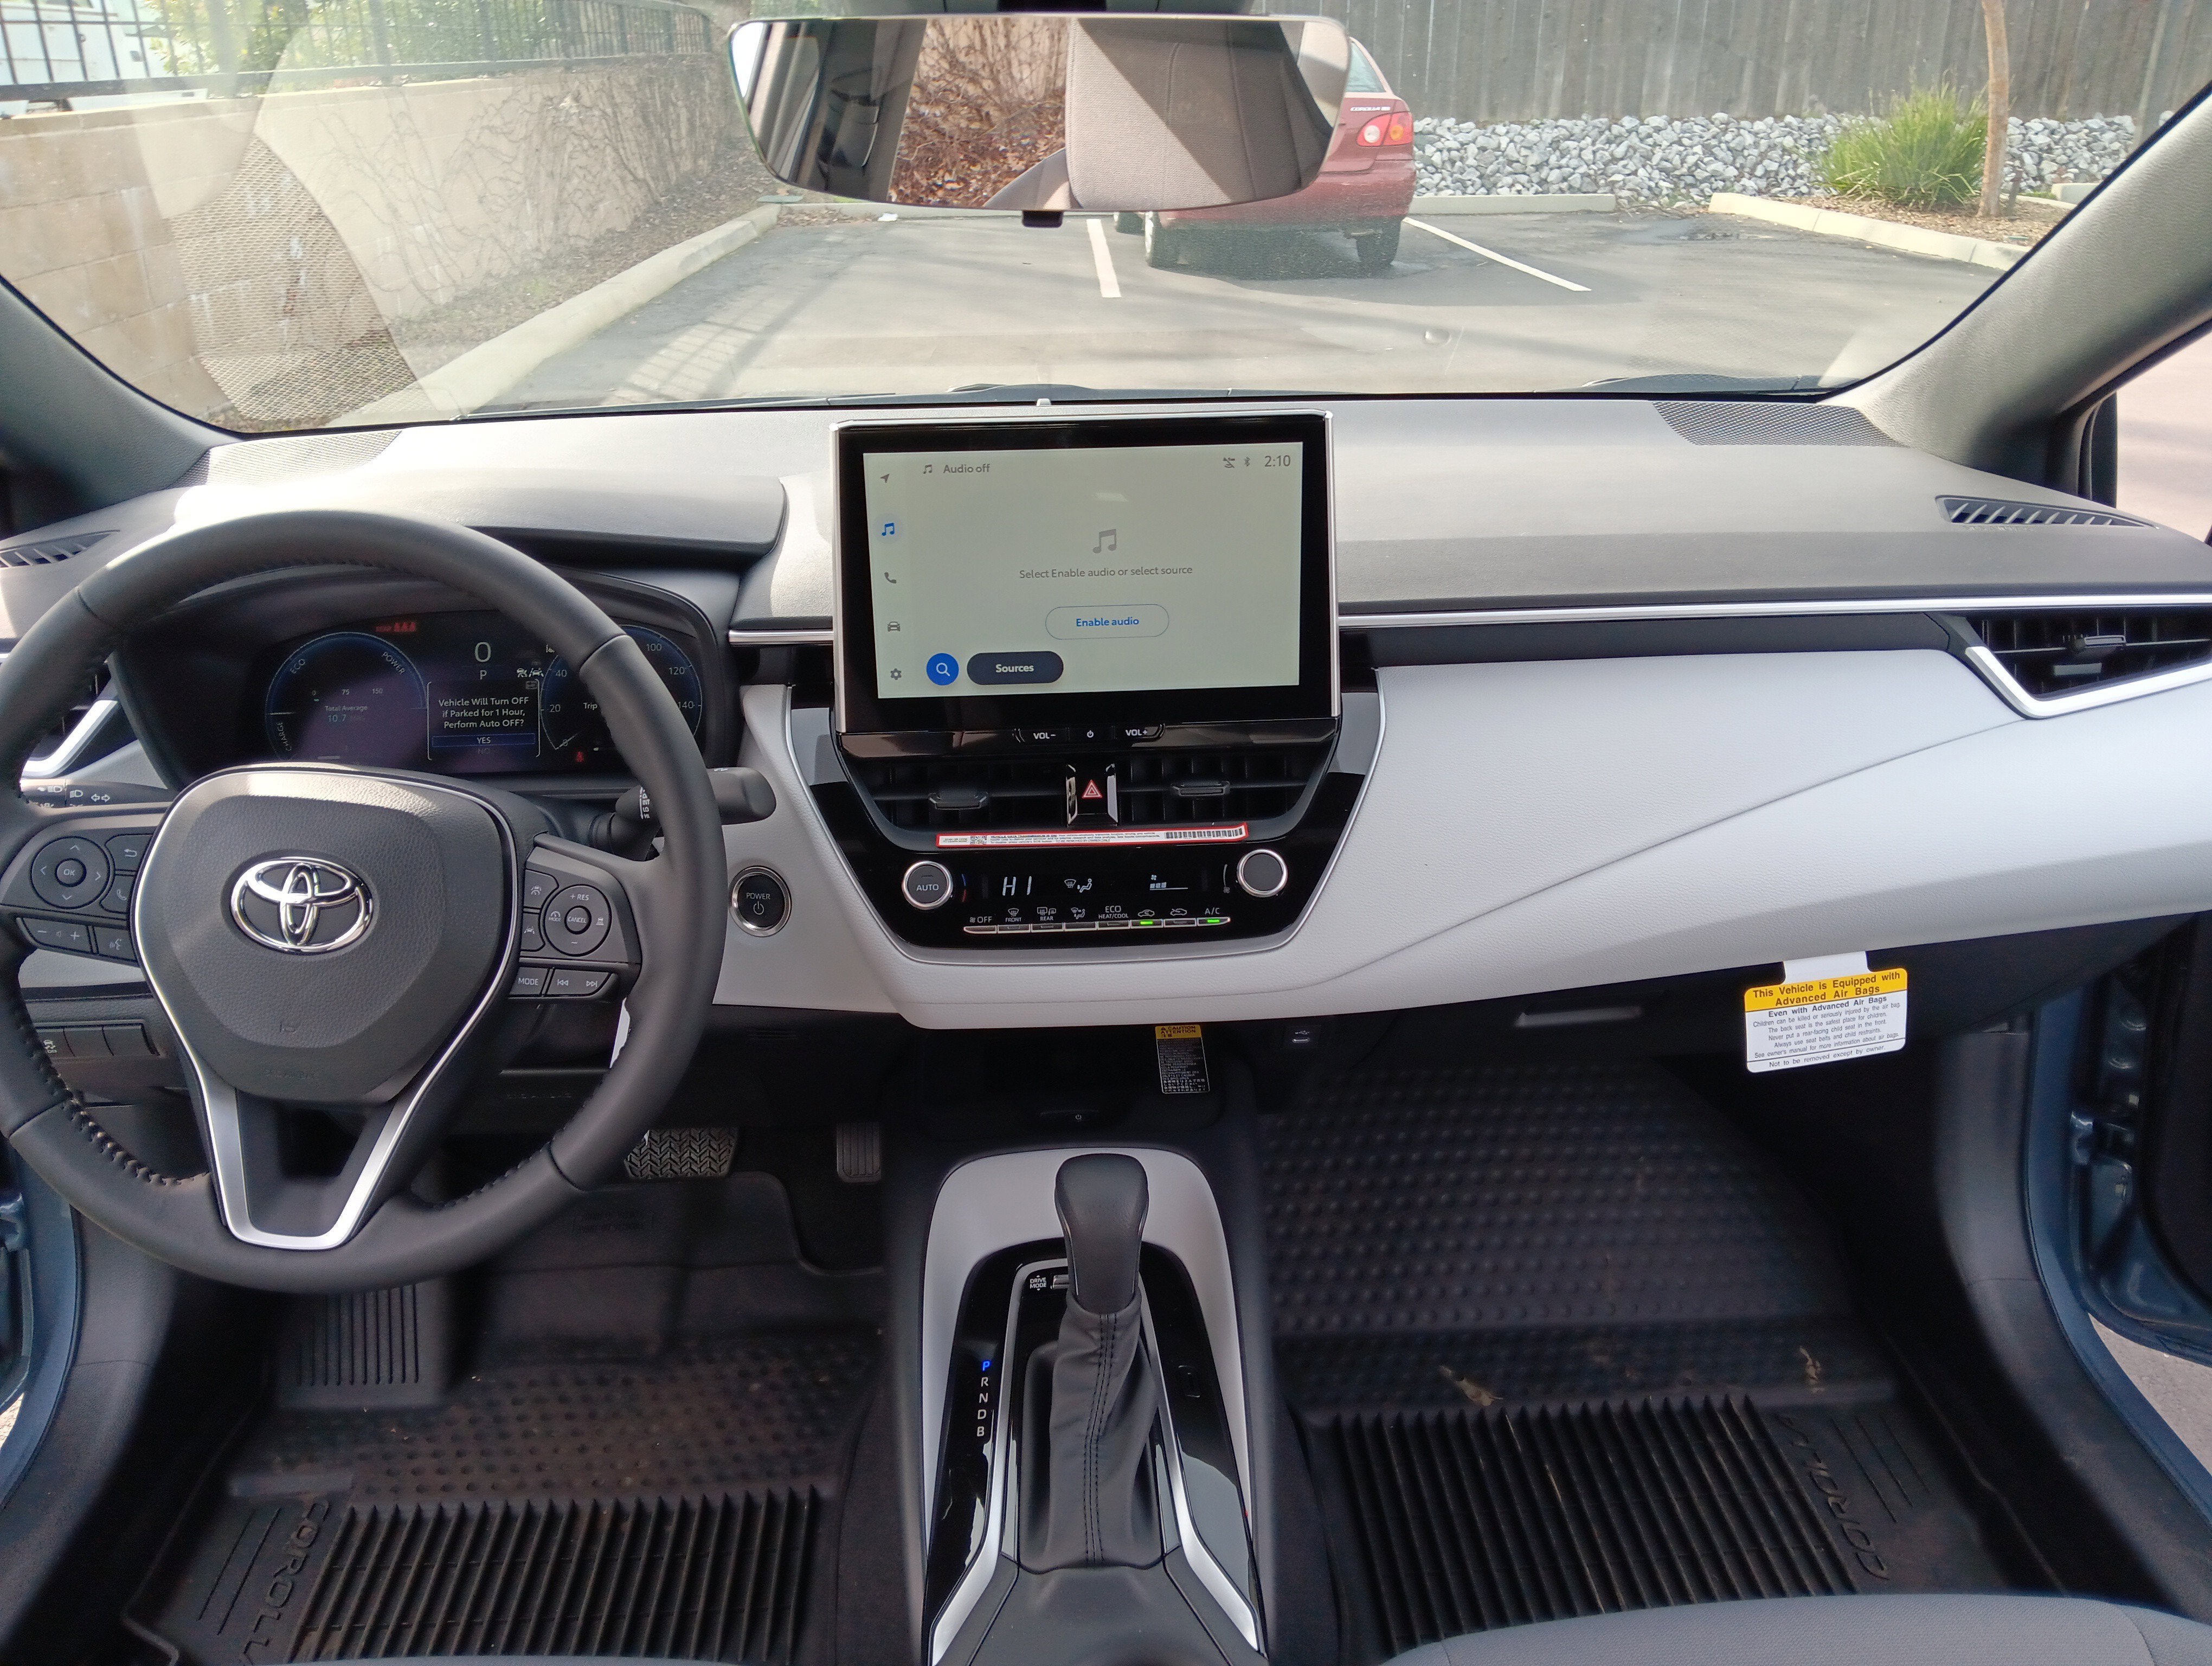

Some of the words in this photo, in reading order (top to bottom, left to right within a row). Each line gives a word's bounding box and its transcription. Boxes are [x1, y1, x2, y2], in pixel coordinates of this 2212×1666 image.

[1264, 455, 1291, 467] 2:10
[943, 463, 974, 473] Audio
[975, 463, 991, 473] off
[1019, 569, 1049, 579] Select
[1051, 568, 1085, 578] Enable
[1088, 568, 1115, 577] audio
[1130, 566, 1159, 575] select
[1076, 617, 1109, 627] Enable
[1111, 617, 1139, 626] audio
[474, 642, 491, 662] 0
[290, 658, 305, 674] ECO
[382, 651, 406, 675] POWER
[995, 663, 1034, 674] Sources
[480, 670, 487, 680] P
[556, 669, 567, 677] 40
[502, 708, 525, 716] Hour,
[549, 704, 561, 713] 20
[444, 721, 477, 729] Perform
[916, 883, 940, 892] AUTO
[518, 977, 538, 985] MODE
[1753, 988, 1773, 998] This
[1779, 983, 1813, 995] Vehicle
[1819, 981, 1826, 990] is
[1833, 975, 1876, 990] Equipped
[1882, 971, 1900, 981] with
[1775, 991, 1825, 1007] Advanced
[1834, 989, 1848, 998] Air
[1855, 984, 1880, 996] Bags
[1769, 1009, 1787, 1017] Even
[1792, 1006, 1807, 1014] with
[1812, 1001, 1849, 1011] Advanced
[1868, 995, 1886, 1004] Bags
[1804, 1053, 1829, 1062] removed
[1833, 1050, 1853, 1059] except
[982, 1360, 990, 1372] P
[981, 1377, 989, 1387] R
[979, 1393, 988, 1402] N
[977, 1409, 987, 1420] D
[976, 1426, 985, 1437] B
